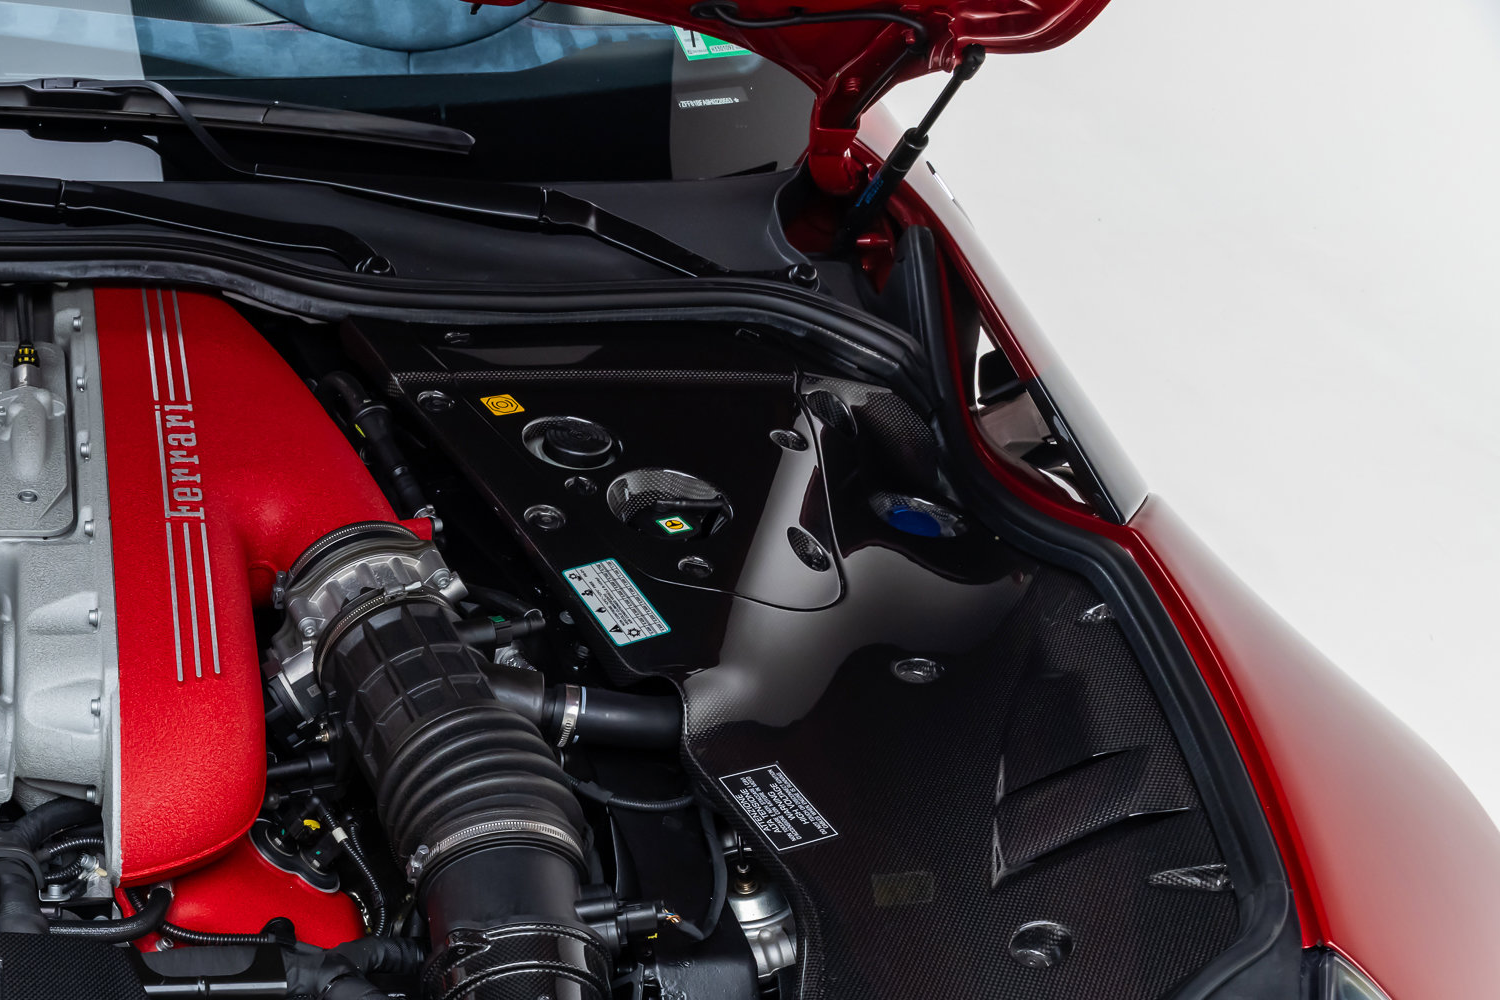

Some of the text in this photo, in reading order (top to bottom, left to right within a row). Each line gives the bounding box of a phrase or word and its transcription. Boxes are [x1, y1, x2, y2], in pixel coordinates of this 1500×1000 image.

[155, 404, 205, 519] Ferrari
[734, 793, 771, 832] ATTENZIONE
[739, 788, 782, 833] ALTA TENSIONE
[766, 790, 796, 820] WARNING
[768, 782, 810, 824] HIGH VOLTAGE
